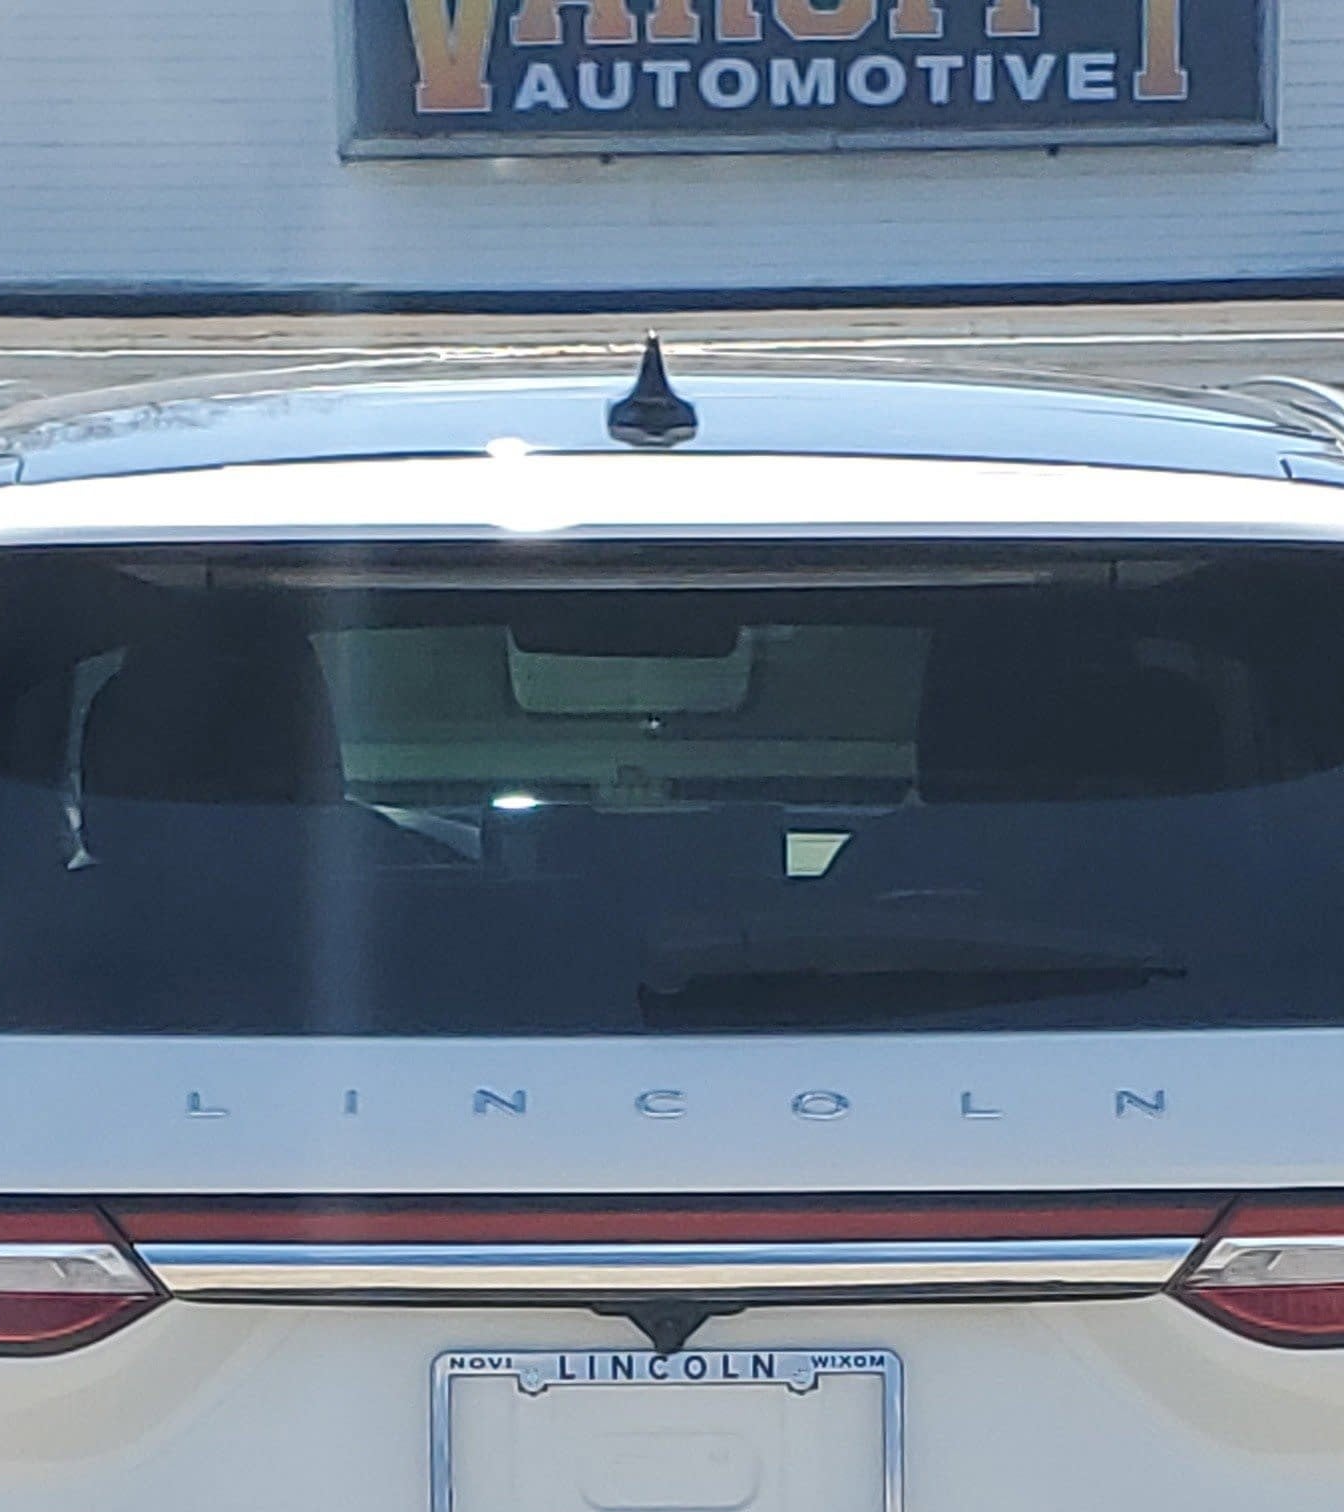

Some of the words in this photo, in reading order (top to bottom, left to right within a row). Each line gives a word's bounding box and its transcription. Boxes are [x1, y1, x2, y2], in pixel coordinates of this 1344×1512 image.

[514, 52, 1117, 109] AUTOMOTIVE
[186, 1088, 1165, 1120] LINCOLN
[450, 1357, 513, 1370] NOVI
[559, 1354, 775, 1380] LINCOLN
[811, 1355, 886, 1369] WIXOM
